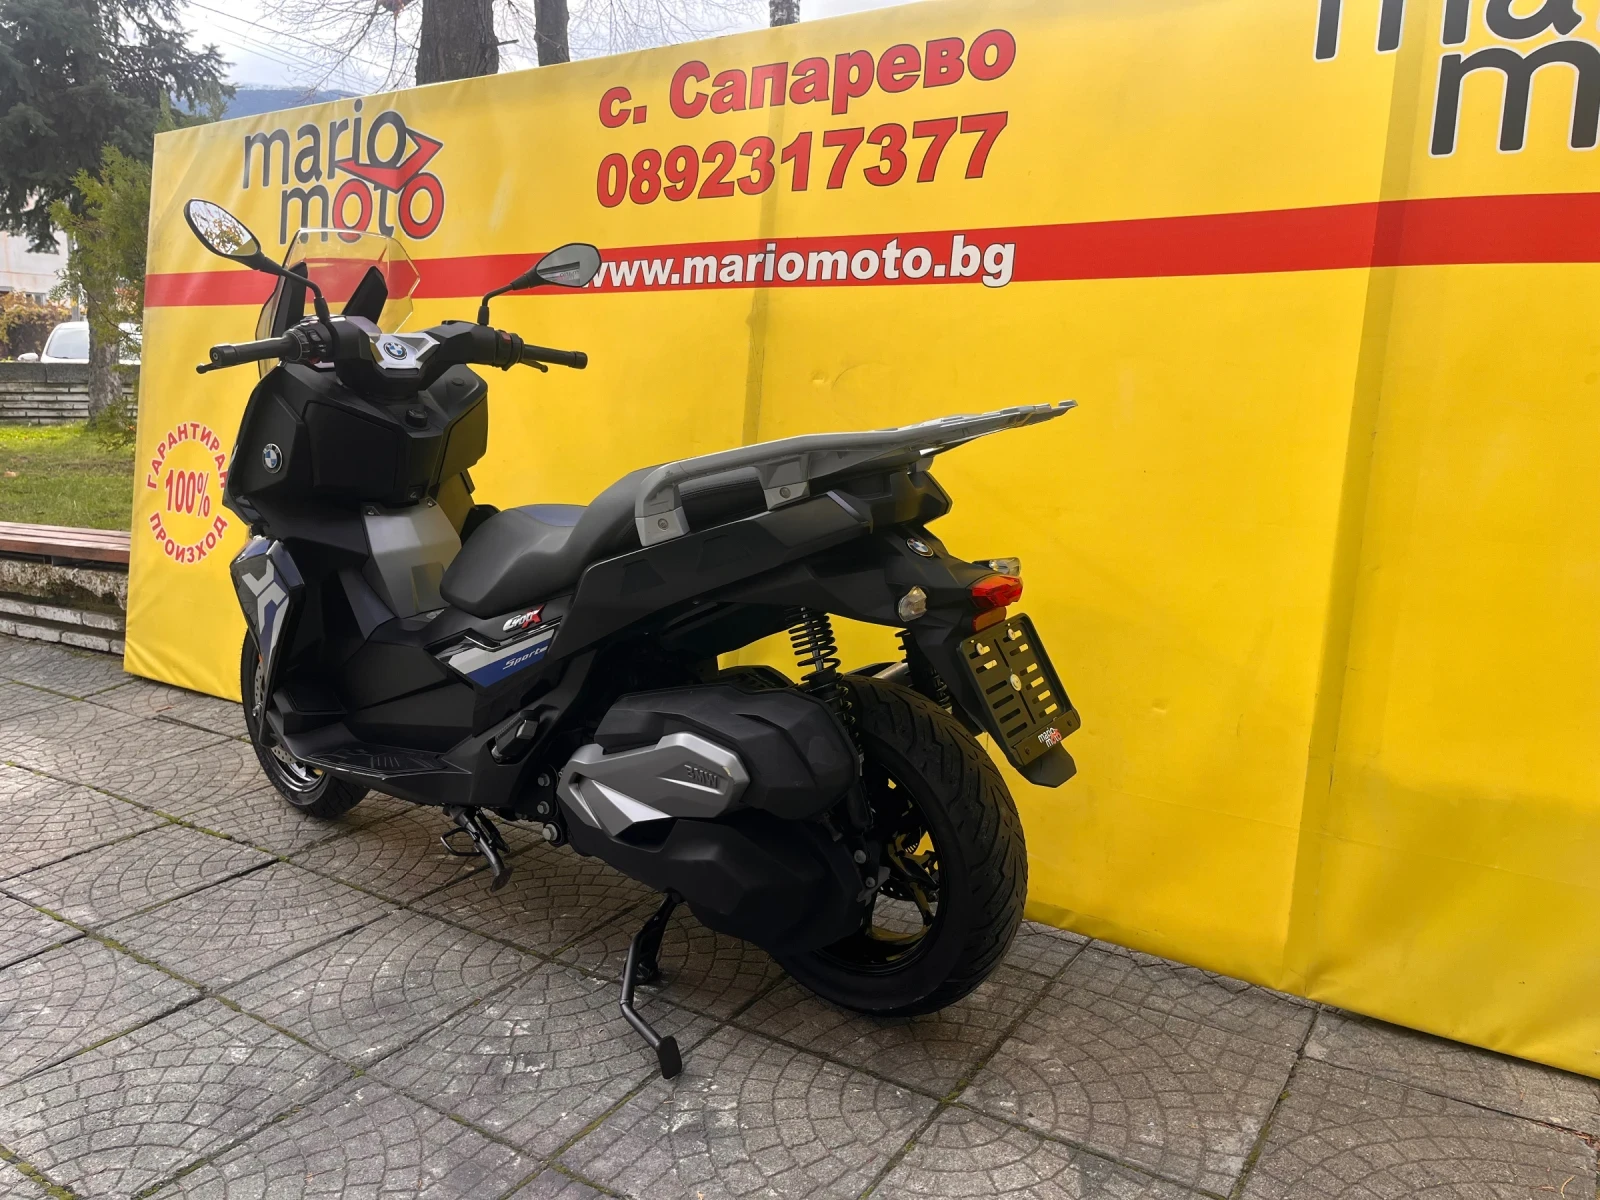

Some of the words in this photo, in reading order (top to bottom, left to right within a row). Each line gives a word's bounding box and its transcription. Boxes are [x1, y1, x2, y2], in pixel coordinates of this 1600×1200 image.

[598, 86, 648, 129] с.
[669, 28, 1017, 119] Сапарево
[242, 98, 408, 190] mario
[596, 110, 1009, 209] 0892317377
[279, 172, 446, 245] moto
[165, 469, 212, 519] 100%
[149, 511, 229, 564] ПРОИЗХОД
[1037, 726, 1056, 744] mario
[683, 763, 718, 790] BMW
